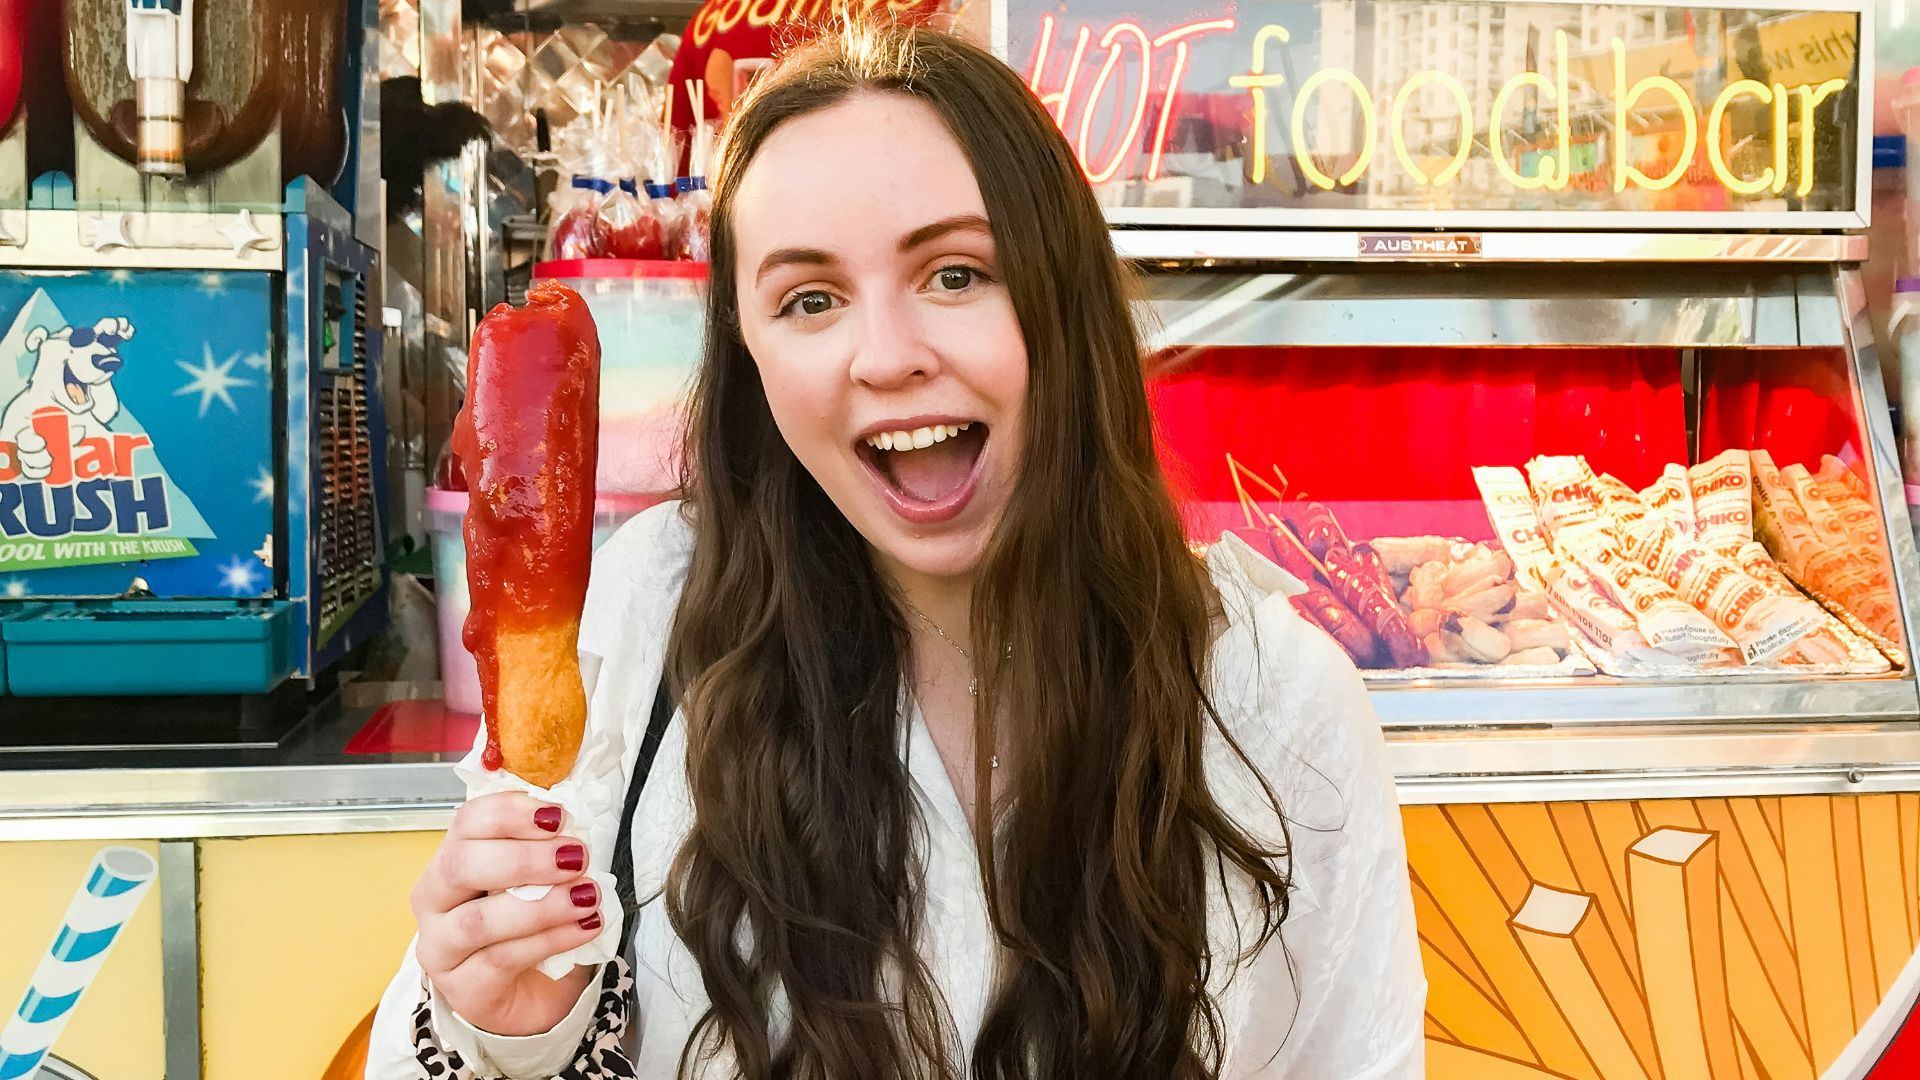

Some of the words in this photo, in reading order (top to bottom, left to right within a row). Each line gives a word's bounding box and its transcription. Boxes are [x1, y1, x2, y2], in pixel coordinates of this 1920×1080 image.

[1028, 15, 1236, 184] HOT
[1229, 24, 1570, 190] food
[1611, 36, 1847, 197] bar
[1374, 240, 1468, 251] AUSTHEAT
[0, 407, 150, 486] olar
[0, 476, 169, 537] RUSH
[1695, 475, 1743, 498] CHIKO
[0, 543, 46, 562] OOL
[54, 541, 106, 560] WITH
[109, 540, 141, 556] THE
[142, 539, 186, 554] KRUSH
